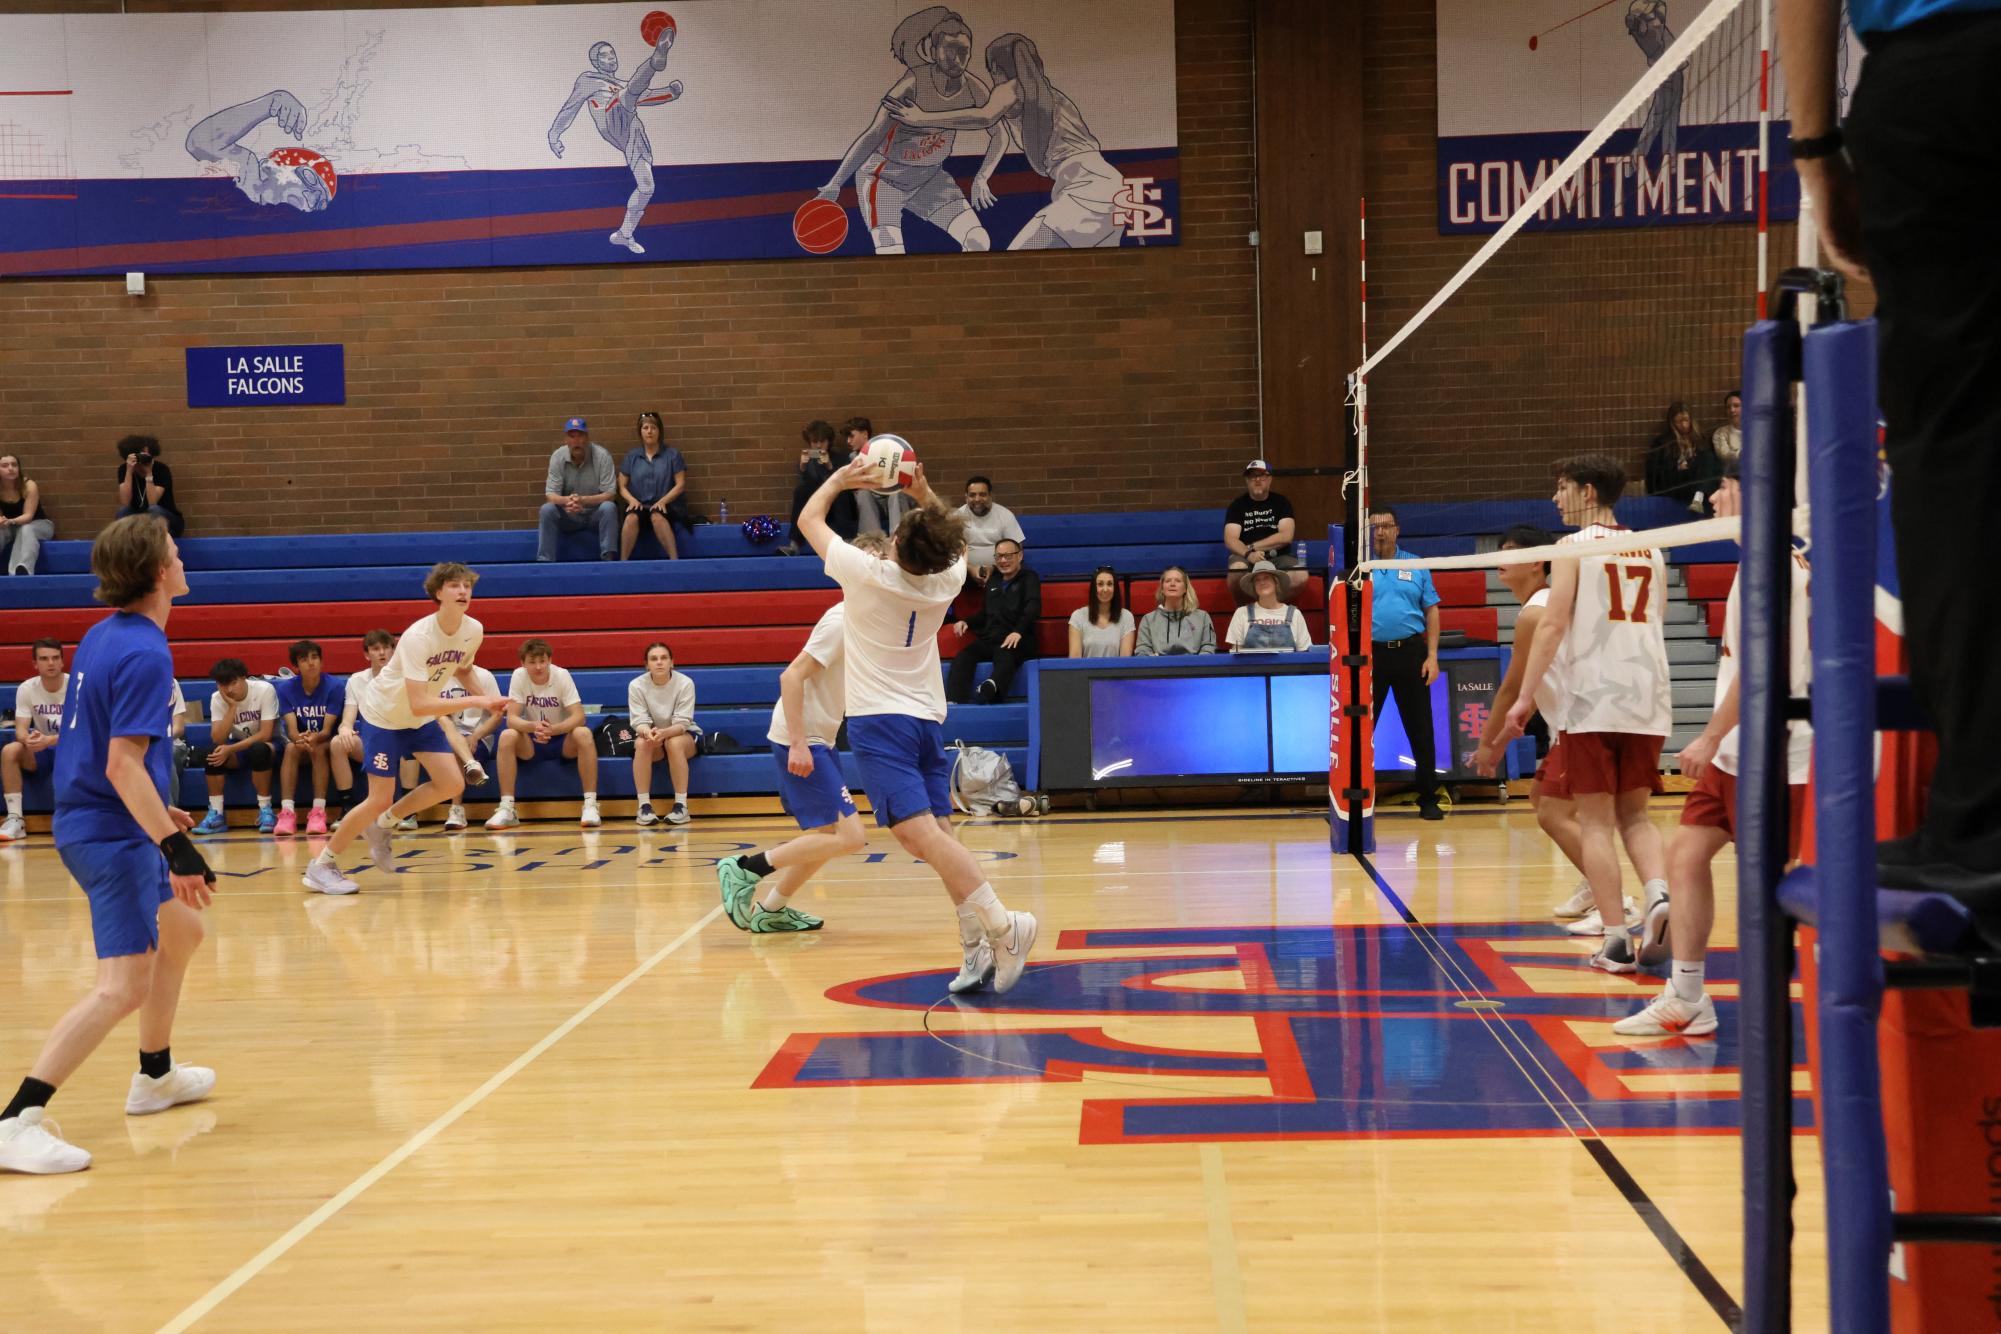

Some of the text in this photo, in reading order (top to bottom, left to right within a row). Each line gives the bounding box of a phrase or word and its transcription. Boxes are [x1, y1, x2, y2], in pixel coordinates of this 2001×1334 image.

[1449, 149, 1760, 224] COMMITMENT
[227, 355, 304, 374] LA SALLE
[228, 377, 304, 395] FALCONS
[1603, 562, 1653, 624] 17
[1329, 672, 1340, 769] SALLE
